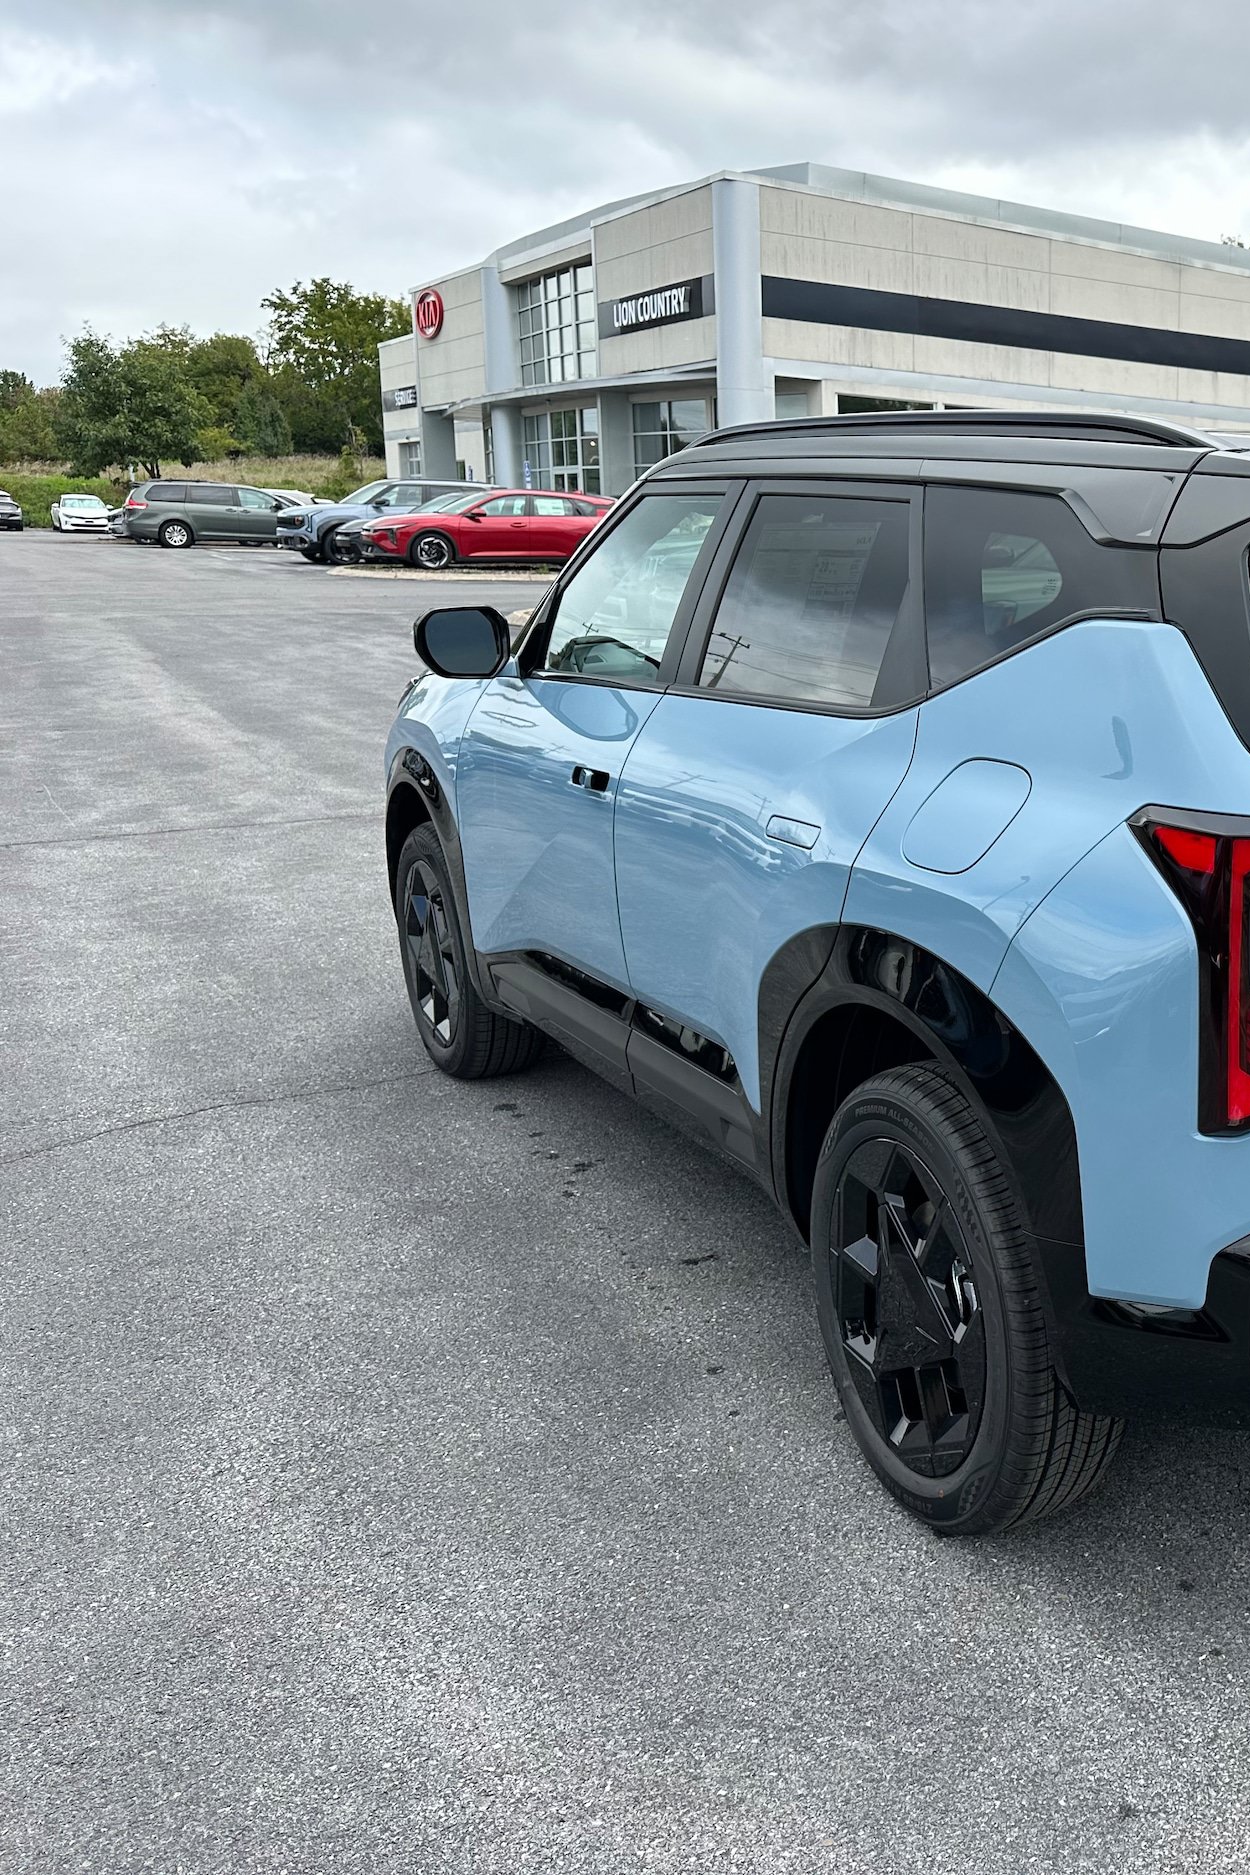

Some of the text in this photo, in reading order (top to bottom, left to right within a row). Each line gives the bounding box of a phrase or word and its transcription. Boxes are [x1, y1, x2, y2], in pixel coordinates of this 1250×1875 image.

[613, 286, 687, 327] LION COUNTRY
[855, 1104, 887, 1117] PREMIUM
